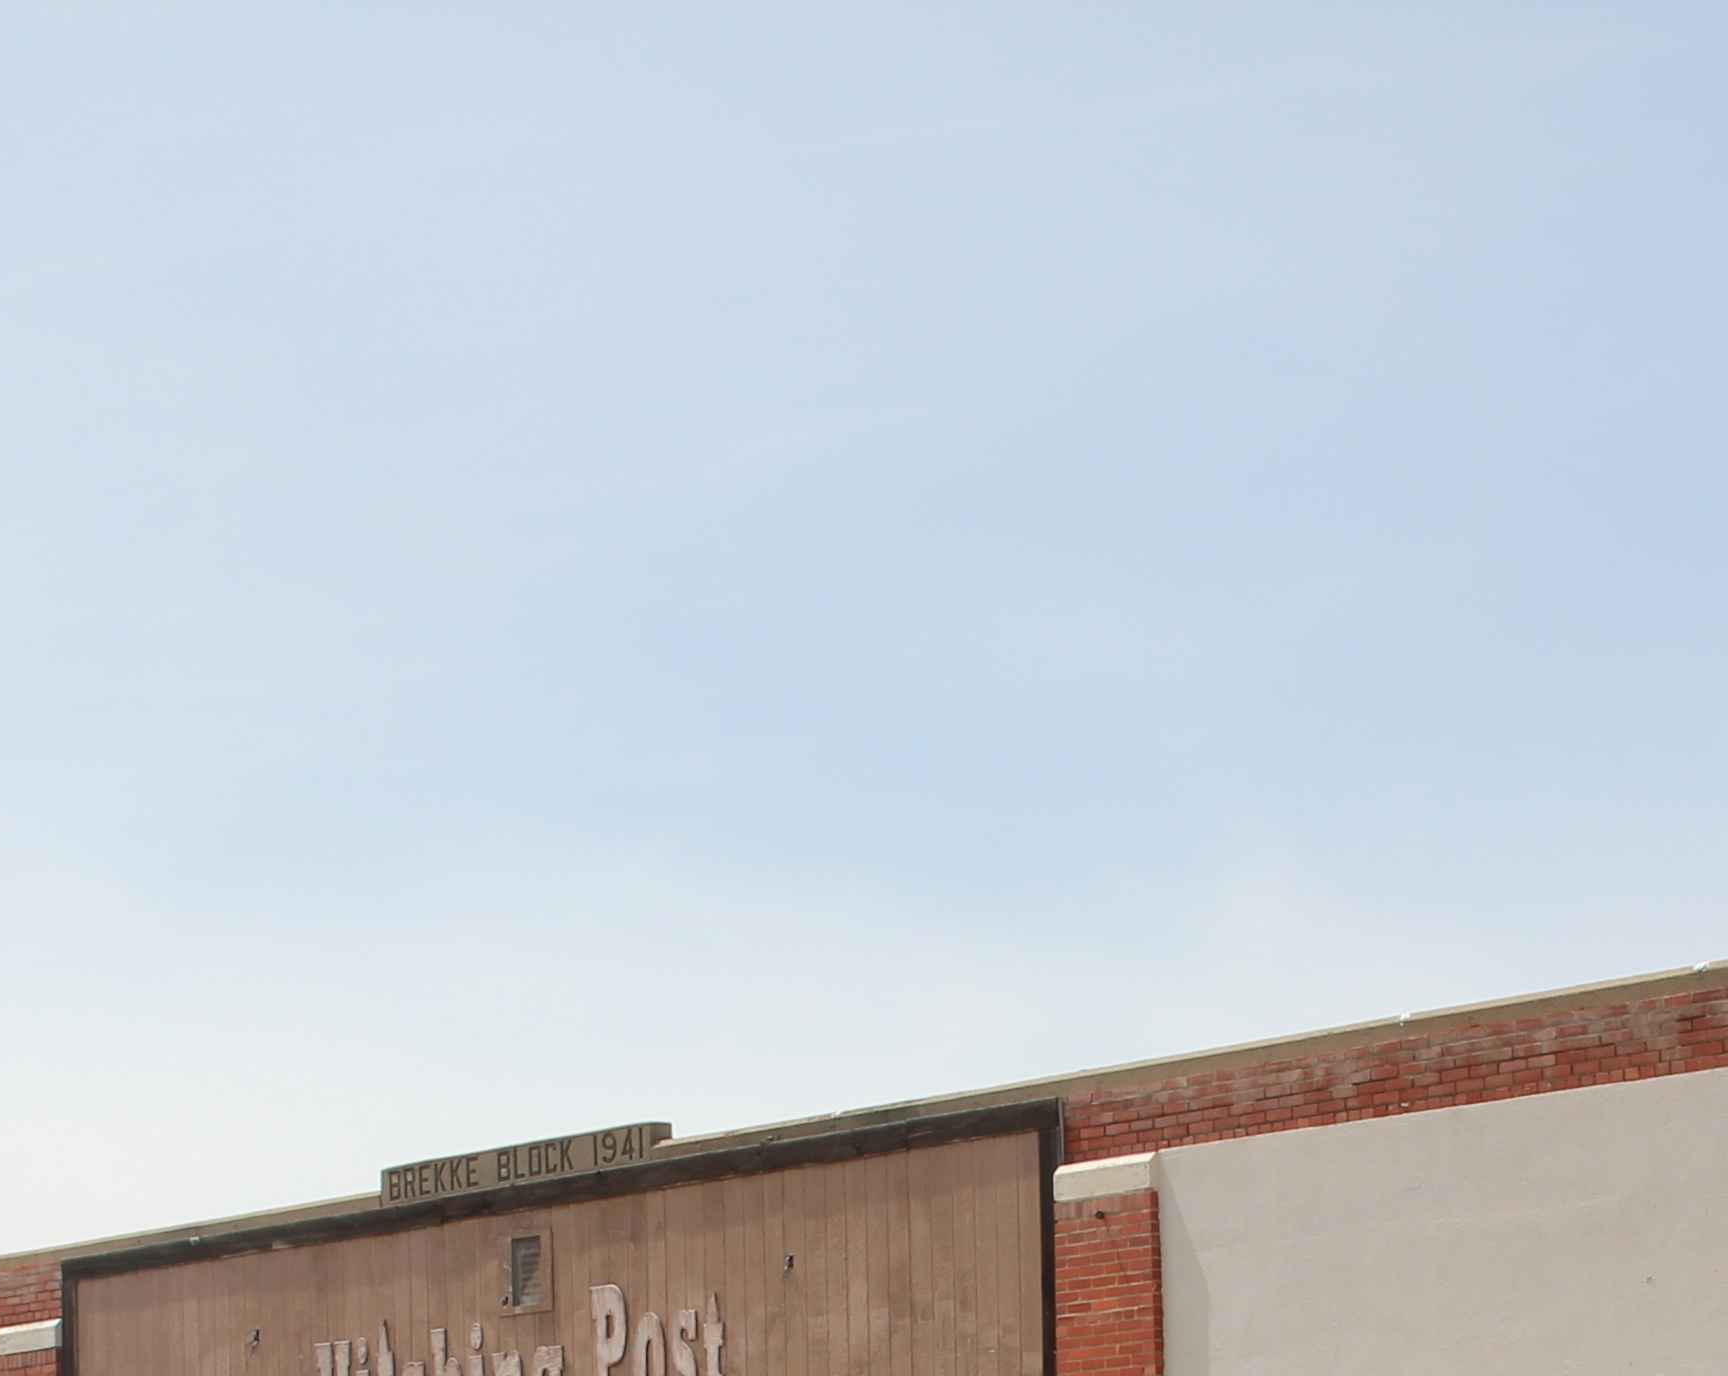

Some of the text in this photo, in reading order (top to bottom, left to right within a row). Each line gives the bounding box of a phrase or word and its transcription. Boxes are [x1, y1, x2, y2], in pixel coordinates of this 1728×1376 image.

[388, 1127, 645, 1202] BREKKE BLOCK 1941
